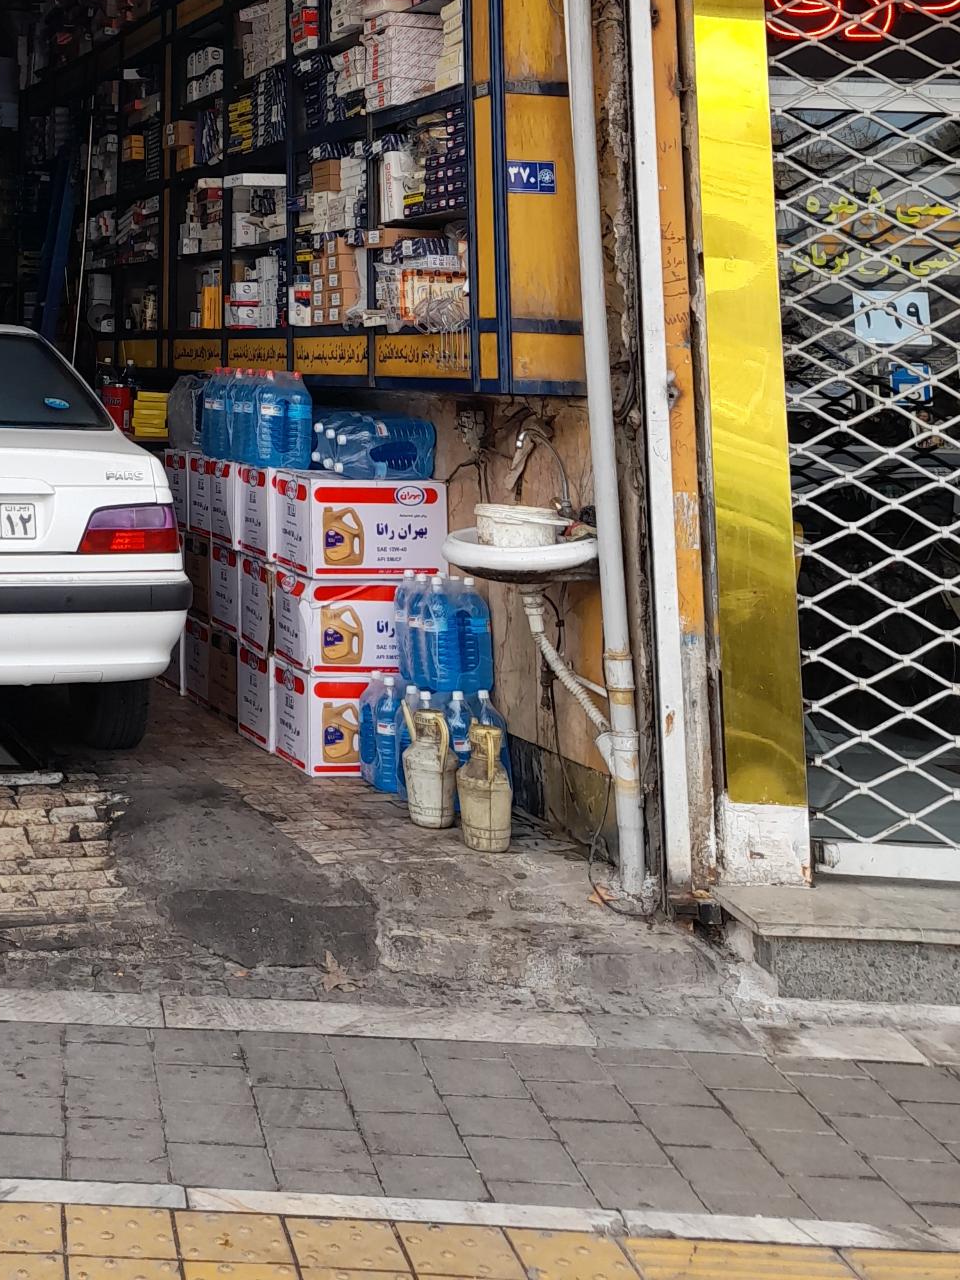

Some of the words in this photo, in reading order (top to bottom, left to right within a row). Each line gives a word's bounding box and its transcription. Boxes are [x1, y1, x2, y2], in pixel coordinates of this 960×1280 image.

[508, 166, 536, 184] ۳۷۰
[105, 471, 145, 481] PARS
[6, 513, 32, 536] ۱۲
[376, 523, 395, 540] رانا
[398, 523, 428, 540] بهران
